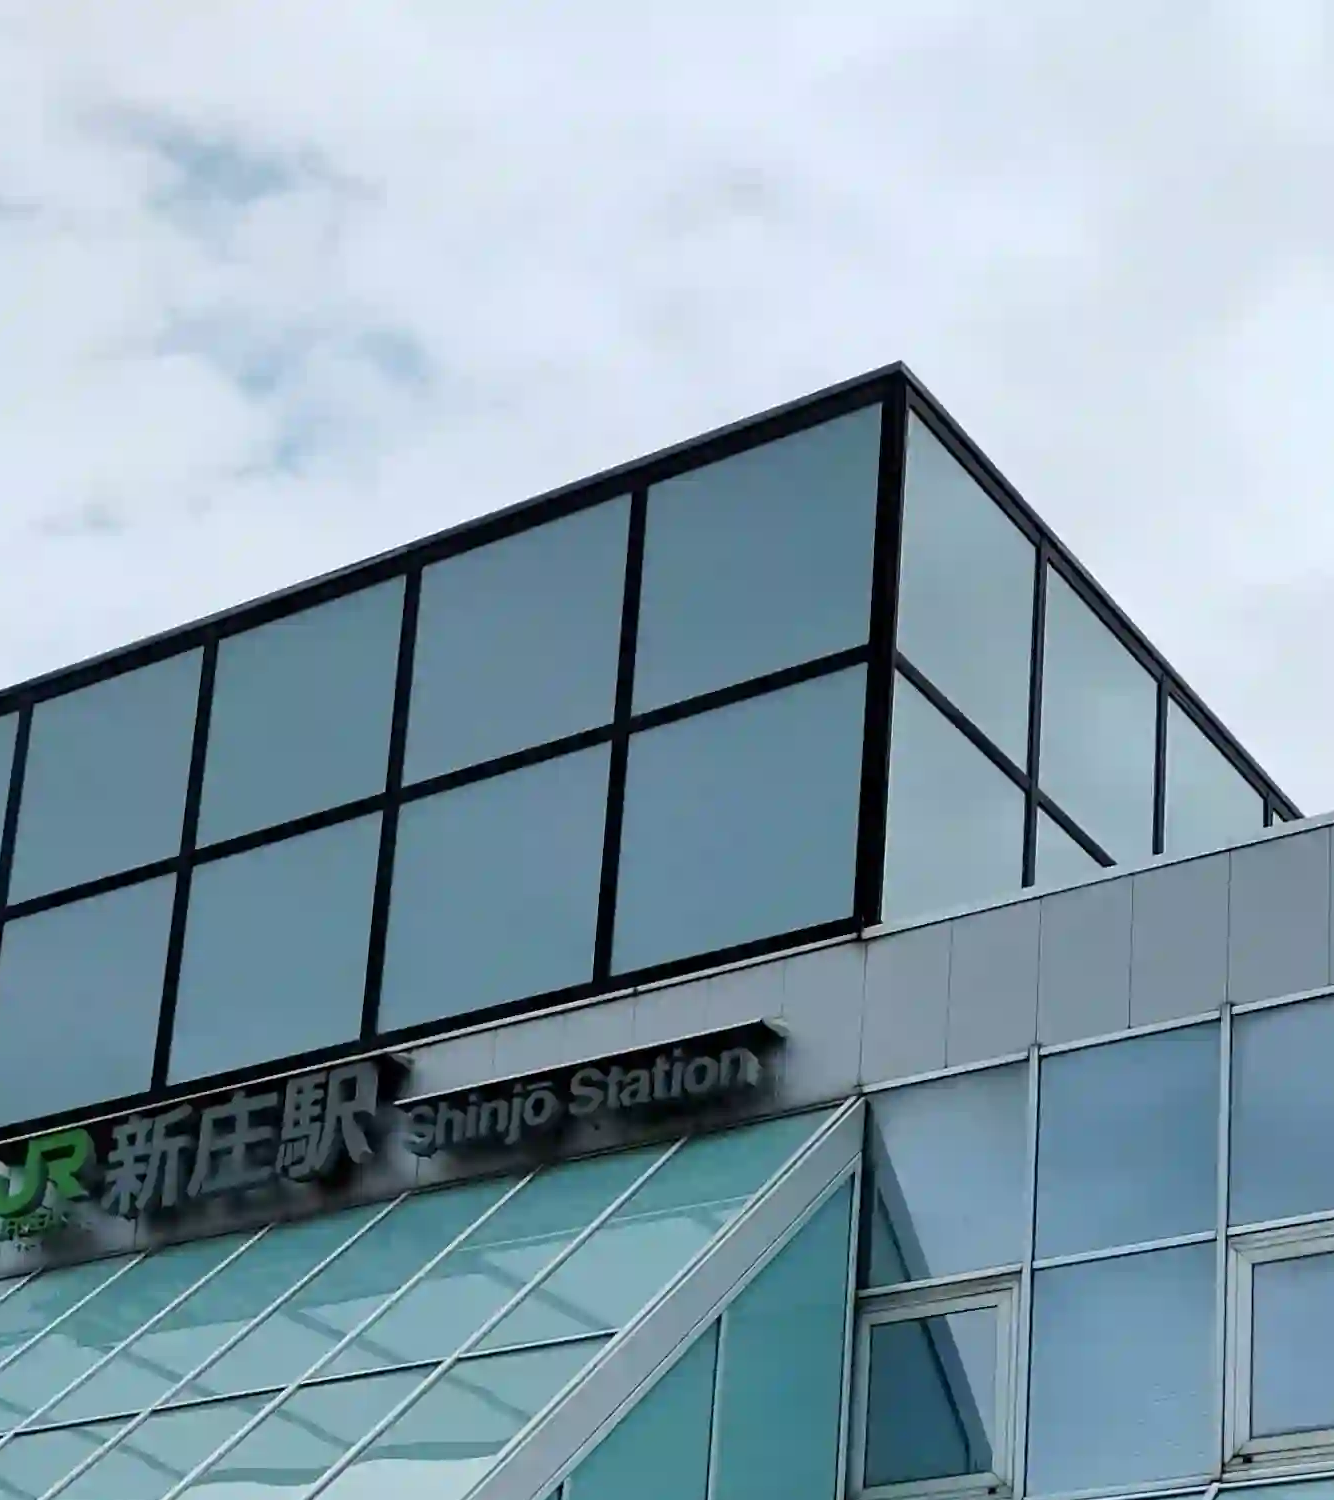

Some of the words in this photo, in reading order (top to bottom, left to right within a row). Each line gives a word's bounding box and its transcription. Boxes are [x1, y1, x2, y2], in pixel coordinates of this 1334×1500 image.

[570, 1047, 763, 1116] Station
[102, 1062, 379, 1218] 新庄駅
